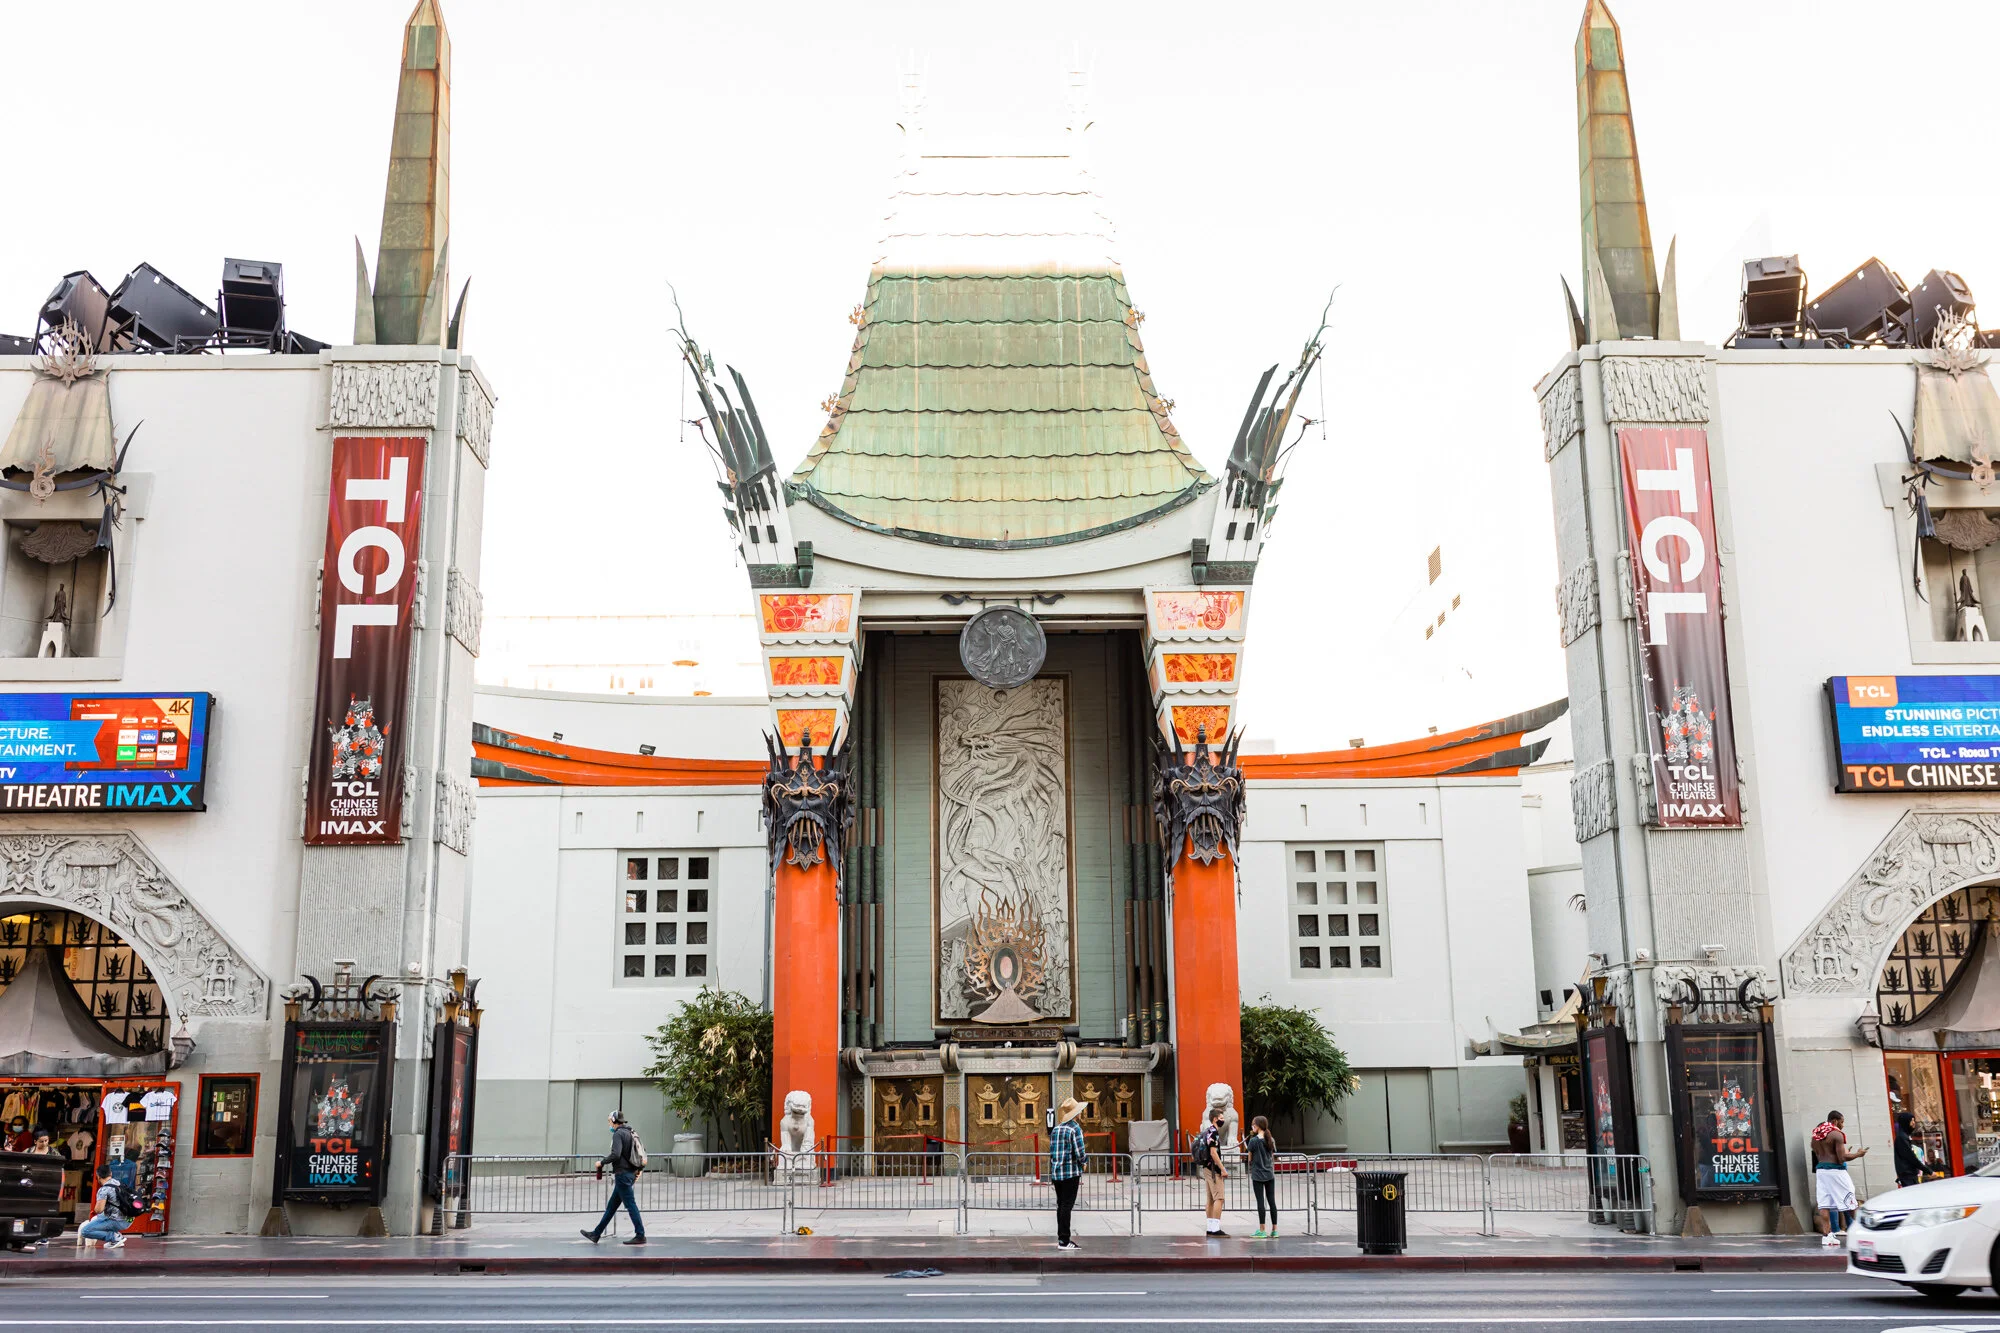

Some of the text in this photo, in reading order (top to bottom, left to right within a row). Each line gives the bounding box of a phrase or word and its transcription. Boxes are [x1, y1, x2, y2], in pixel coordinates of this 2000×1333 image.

[1637, 447, 1708, 646] TCL
[333, 456, 410, 659] TCL
[1854, 685, 1891, 698] TCL
[168, 700, 191, 713] 4K
[1885, 708, 2000, 720] STUNNING PICT
[1862, 725, 1930, 737] ENDLESS
[1919, 747, 1950, 758] TCL
[0, 767, 17, 778] TV
[1668, 765, 1715, 780] TCL
[1847, 764, 1998, 787] TCL CHINESE
[331, 781, 379, 797] TCL
[1669, 782, 1716, 792] CHINESE
[3, 784, 193, 808] THEATRE IMAX
[1670, 791, 1717, 800] THEATRES
[330, 798, 379, 808] CHINESE
[330, 808, 378, 817] THEATRES
[1663, 803, 1726, 818] IMAX
[320, 820, 385, 835] IMAX
[957, 1030, 979, 1038] TCL
[310, 1138, 359, 1154] TCL
[1711, 1137, 1759, 1154] TCL
[308, 1154, 358, 1165] CHINESE
[1712, 1154, 1760, 1164] CHINESE
[308, 1164, 358, 1174] THEATRE
[1712, 1163, 1760, 1173] THEATRE
[309, 1173, 357, 1184] IMAX
[1714, 1173, 1761, 1183] IMAX
